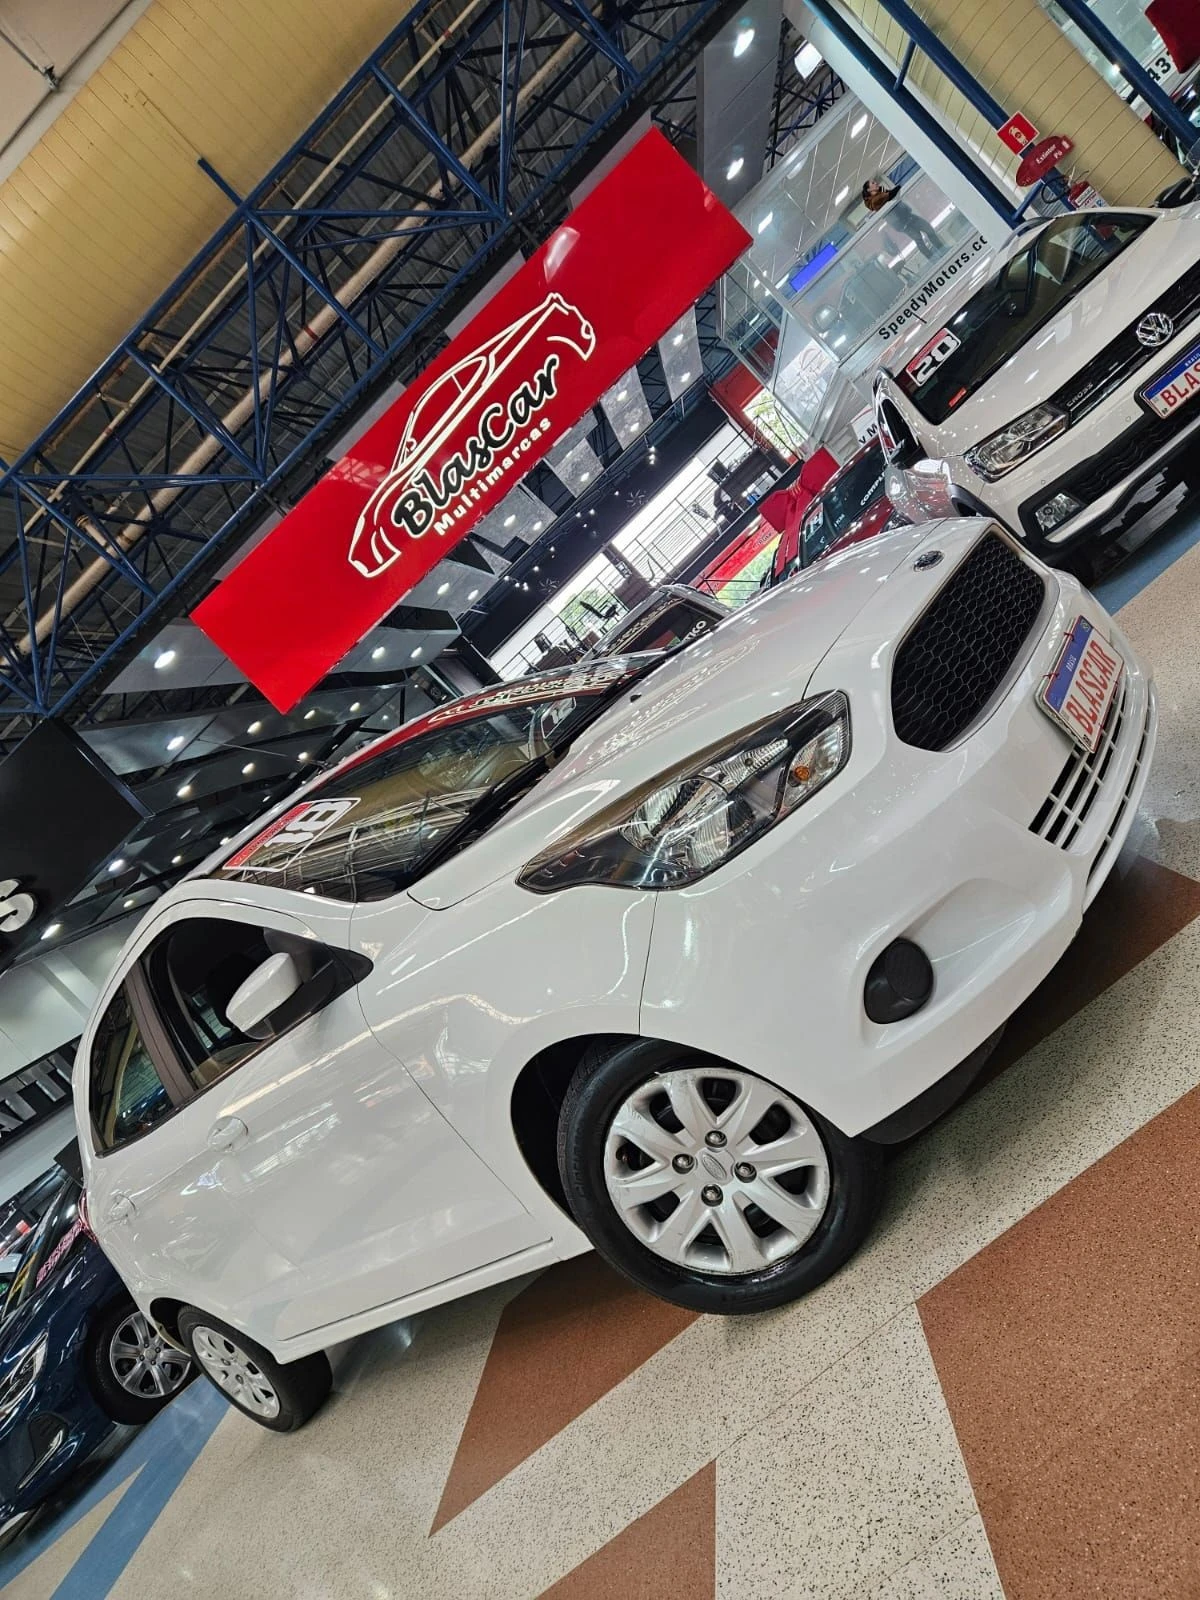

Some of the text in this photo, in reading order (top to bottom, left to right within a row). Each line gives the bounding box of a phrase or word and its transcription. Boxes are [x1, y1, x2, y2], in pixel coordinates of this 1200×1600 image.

[1035, 144, 1057, 164] Extintor
[916, 335, 957, 382] 20
[391, 353, 560, 538] BlasCar
[433, 417, 552, 536] Multimarcas
[1066, 639, 1117, 736] BLASCAR
[263, 801, 352, 848] 18
